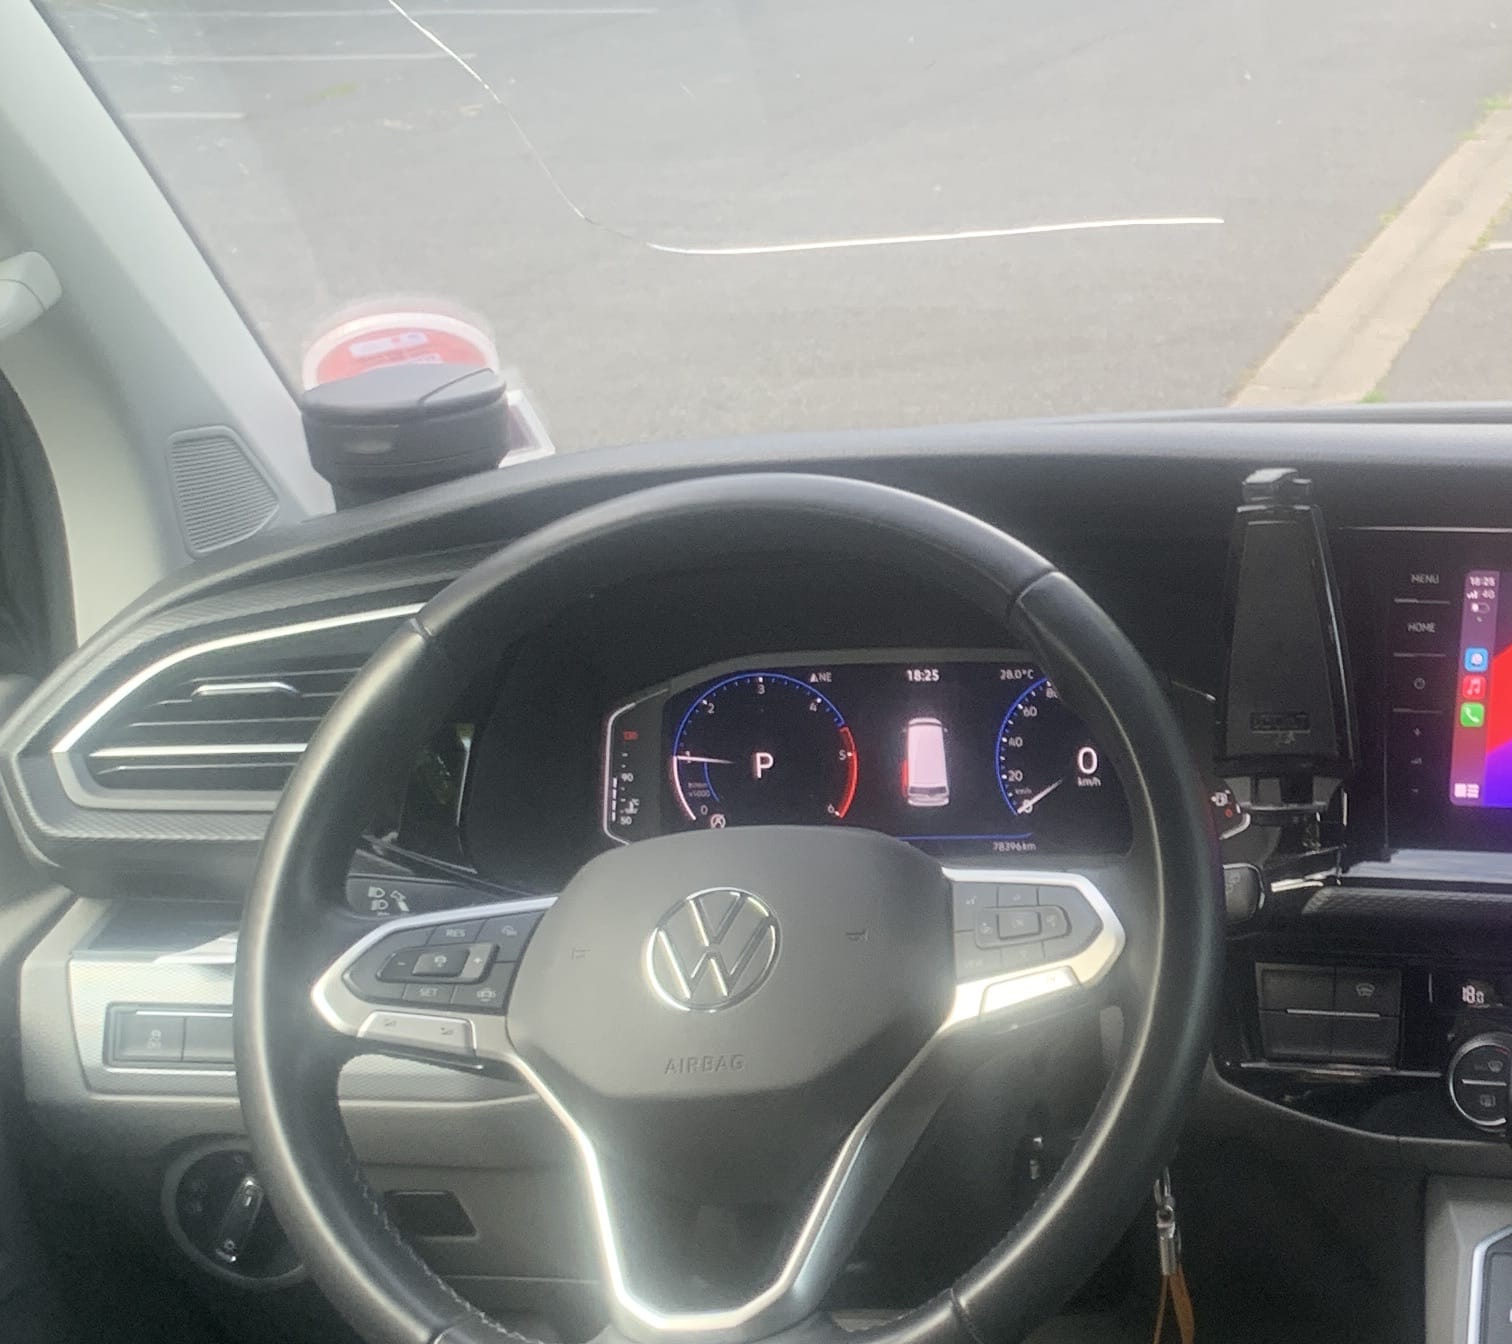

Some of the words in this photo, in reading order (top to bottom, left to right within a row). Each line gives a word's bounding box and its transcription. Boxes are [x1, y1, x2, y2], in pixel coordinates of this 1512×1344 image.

[1410, 573, 1441, 585] MENU
[1407, 622, 1438, 633] HOME
[906, 669, 940, 682] 18:25
[757, 684, 766, 695] 3
[707, 702, 715, 714] 2
[1023, 706, 1038, 717] 60
[1008, 736, 1024, 748] 40
[839, 750, 846, 760] 5
[1077, 746, 1098, 775] 0
[755, 751, 774, 778] P
[1007, 770, 1024, 782] 20
[1077, 776, 1102, 788] km/h
[827, 803, 836, 814] 6
[446, 928, 466, 938] RES
[419, 987, 438, 997] SET
[664, 1053, 746, 1076] AIRBAG
